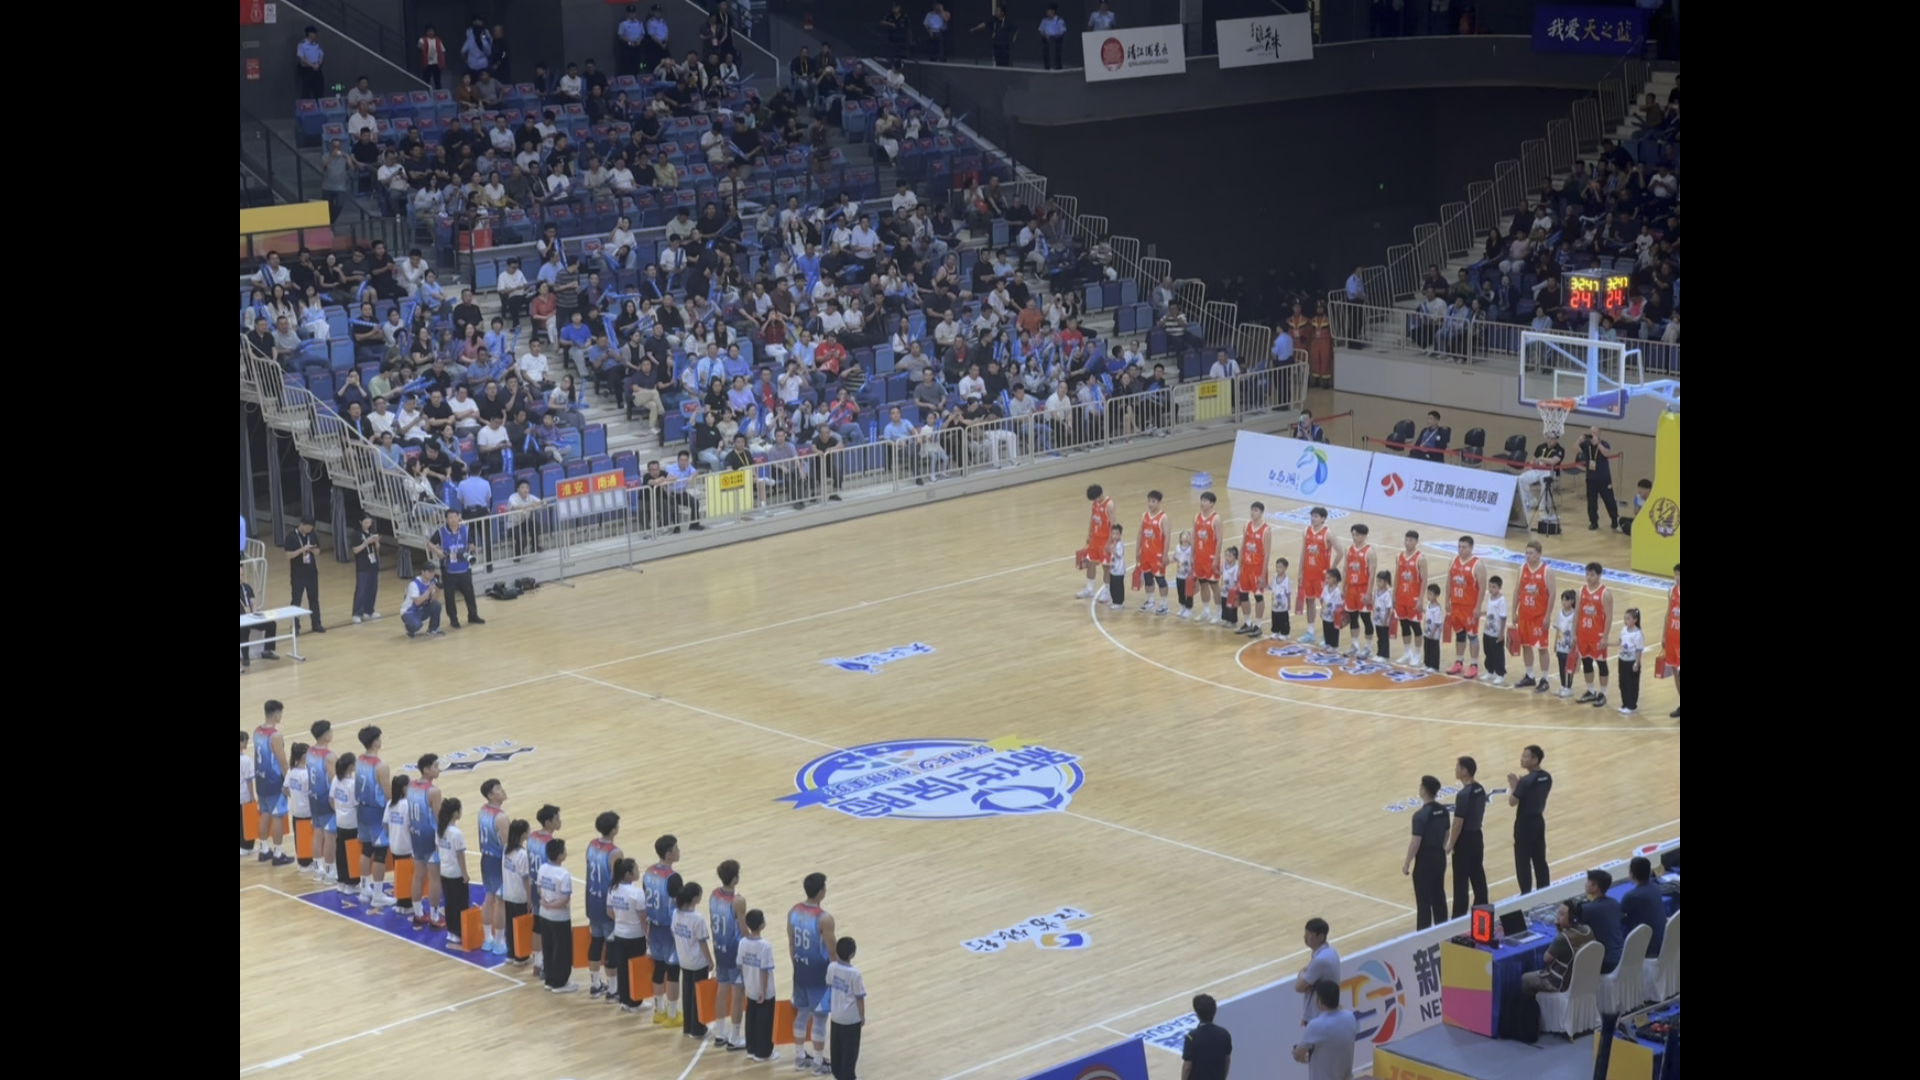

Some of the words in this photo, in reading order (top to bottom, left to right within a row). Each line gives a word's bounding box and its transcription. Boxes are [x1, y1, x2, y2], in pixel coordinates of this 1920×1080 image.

[1570, 290, 1592, 309] 24
[1606, 289, 1622, 309] 24
[561, 481, 585, 498] 淮安
[597, 474, 618, 491] 南通
[1413, 478, 1500, 506] 江苏体育休闲频道
[1524, 595, 1536, 607] 55
[309, 768, 317, 785] 6
[360, 774, 367, 794] 7
[826, 744, 1078, 818] 新华保险
[409, 802, 421, 822] 10
[530, 854, 542, 873] 20
[590, 861, 602, 884] 21
[645, 889, 660, 911] 23
[712, 913, 727, 937] 31
[1473, 908, 1492, 943] 0
[794, 926, 811, 951] 66
[1412, 943, 1442, 998] 新
[1419, 997, 1443, 1022] NE
[1134, 1012, 1198, 1041] EAGUE
